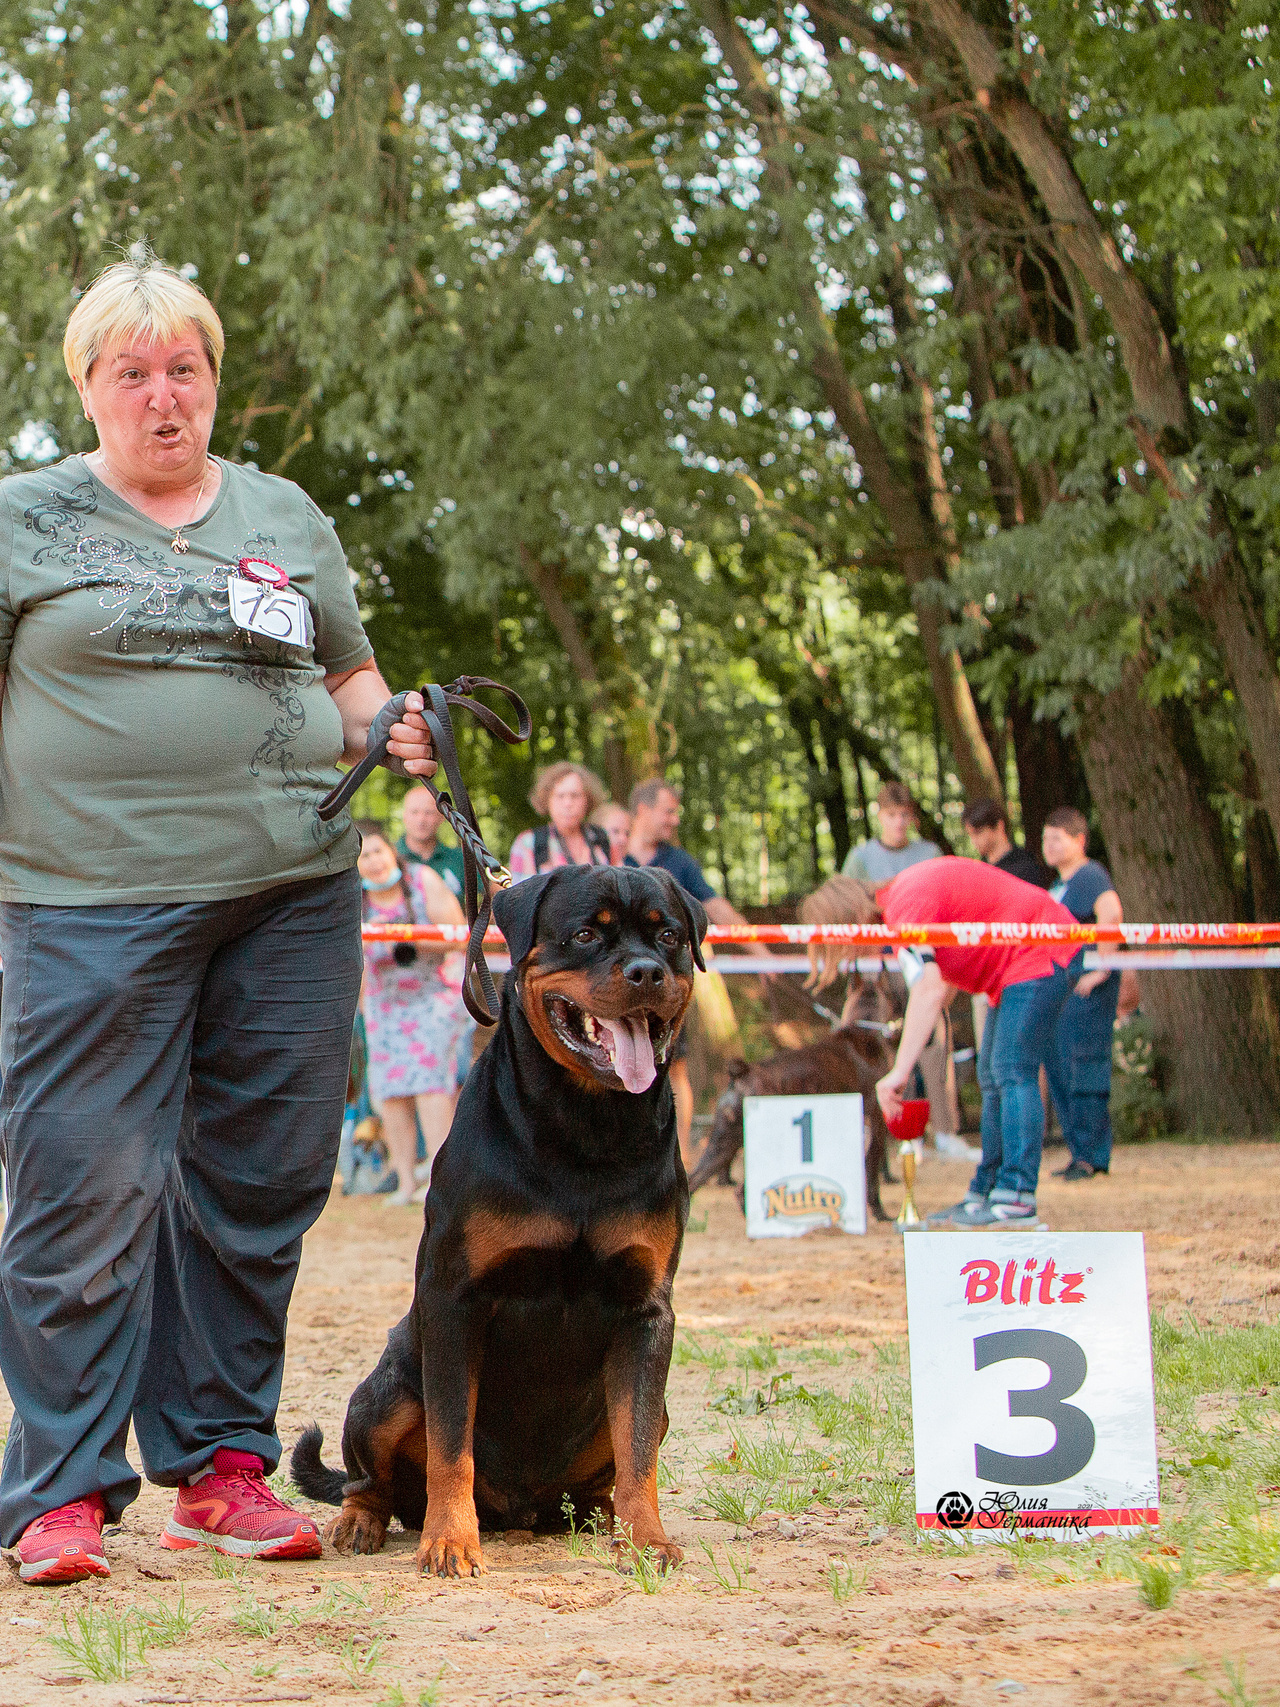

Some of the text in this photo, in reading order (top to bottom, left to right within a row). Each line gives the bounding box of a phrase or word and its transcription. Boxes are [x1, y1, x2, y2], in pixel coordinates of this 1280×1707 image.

[901, 923, 929, 943] Dog
[990, 922, 1096, 943] PRO PAC Dog
[1159, 923, 1264, 943] PRO PAC Dog
[792, 1109, 813, 1163] 1
[763, 1182, 842, 1227] Nutro
[973, 1328, 1096, 1486] 3
